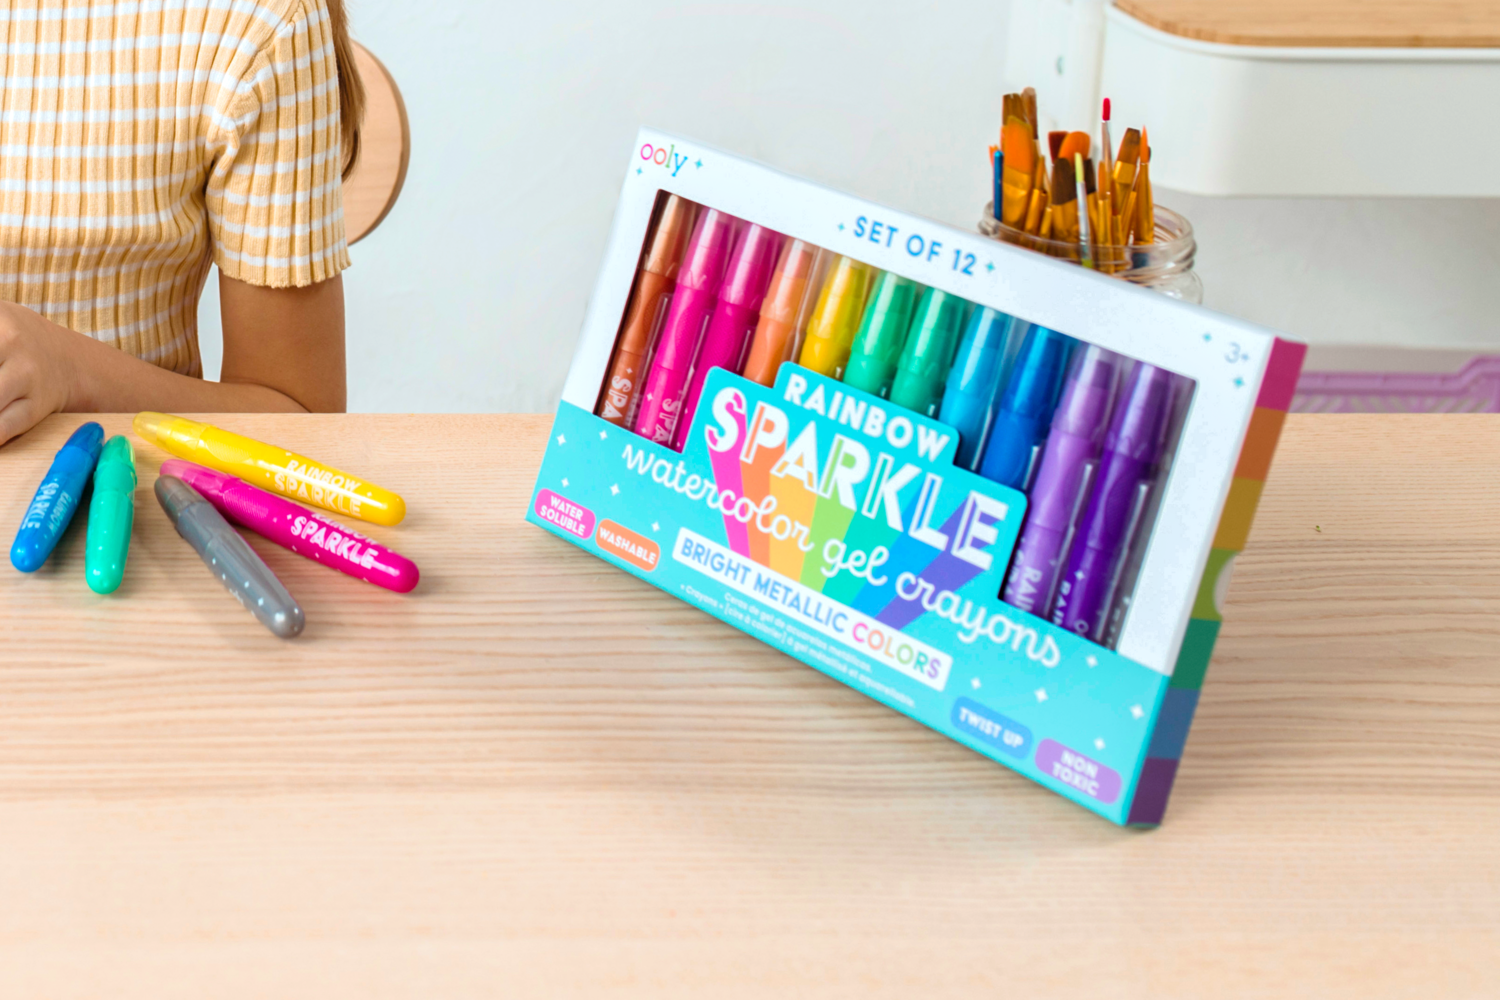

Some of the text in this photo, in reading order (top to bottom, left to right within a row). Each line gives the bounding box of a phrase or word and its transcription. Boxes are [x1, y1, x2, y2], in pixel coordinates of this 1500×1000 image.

[640, 144, 688, 177] ooly
[854, 215, 977, 276] SET OF 12
[1224, 341, 1250, 364] 3+
[783, 373, 950, 462] RAINBOW
[274, 472, 361, 517] SPARKLE
[286, 459, 362, 492] RAINBOW
[704, 386, 1009, 570] SPARKLE
[540, 505, 586, 536] SOLUBLE
[550, 495, 583, 521] WATER
[290, 516, 379, 570] SPARKLE
[599, 526, 656, 565] WASHABLE
[621, 445, 814, 552] watercolor
[820, 538, 889, 586] gel
[895, 571, 1061, 668] crayons
[680, 537, 941, 679] BRIGHT METALLIC COLORS
[959, 706, 1024, 748] TWIST UP
[1052, 761, 1099, 796] TOXIC
[1061, 751, 1099, 778] NON
